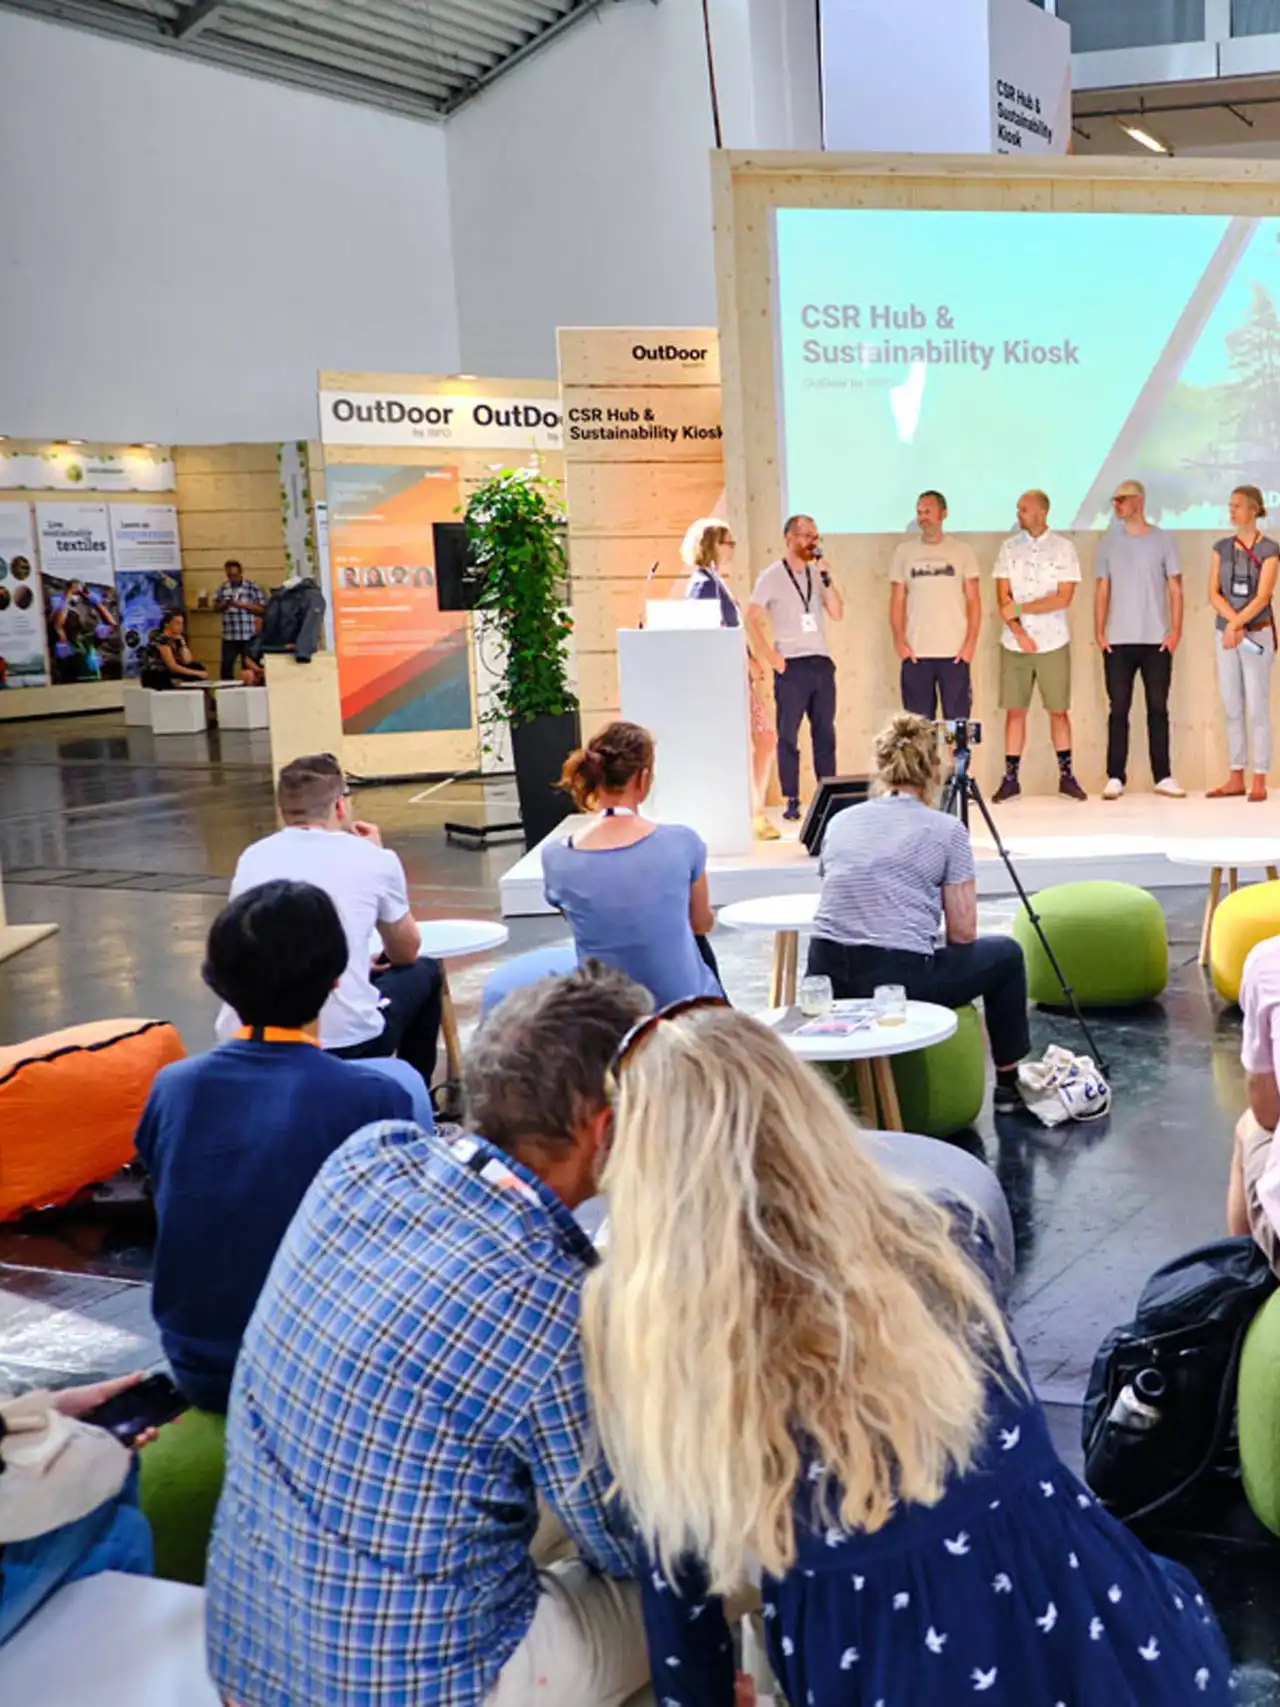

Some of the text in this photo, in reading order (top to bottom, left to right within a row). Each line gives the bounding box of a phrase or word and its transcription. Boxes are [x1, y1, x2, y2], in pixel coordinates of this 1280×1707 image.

[997, 79, 1042, 115] CSR Hub &
[997, 101, 1052, 145] Sustainability
[997, 123, 1021, 148] Kiosk
[801, 303, 955, 330] CSR Hub &
[632, 345, 708, 361] OutDoor
[802, 338, 1080, 371] Sustainability Kiosk
[332, 398, 454, 425] OutDoor
[473, 404, 563, 428] OutDo
[568, 408, 656, 422] CSR Hub &
[570, 426, 679, 443] Sustainability
[56, 537, 107, 553] textiles
